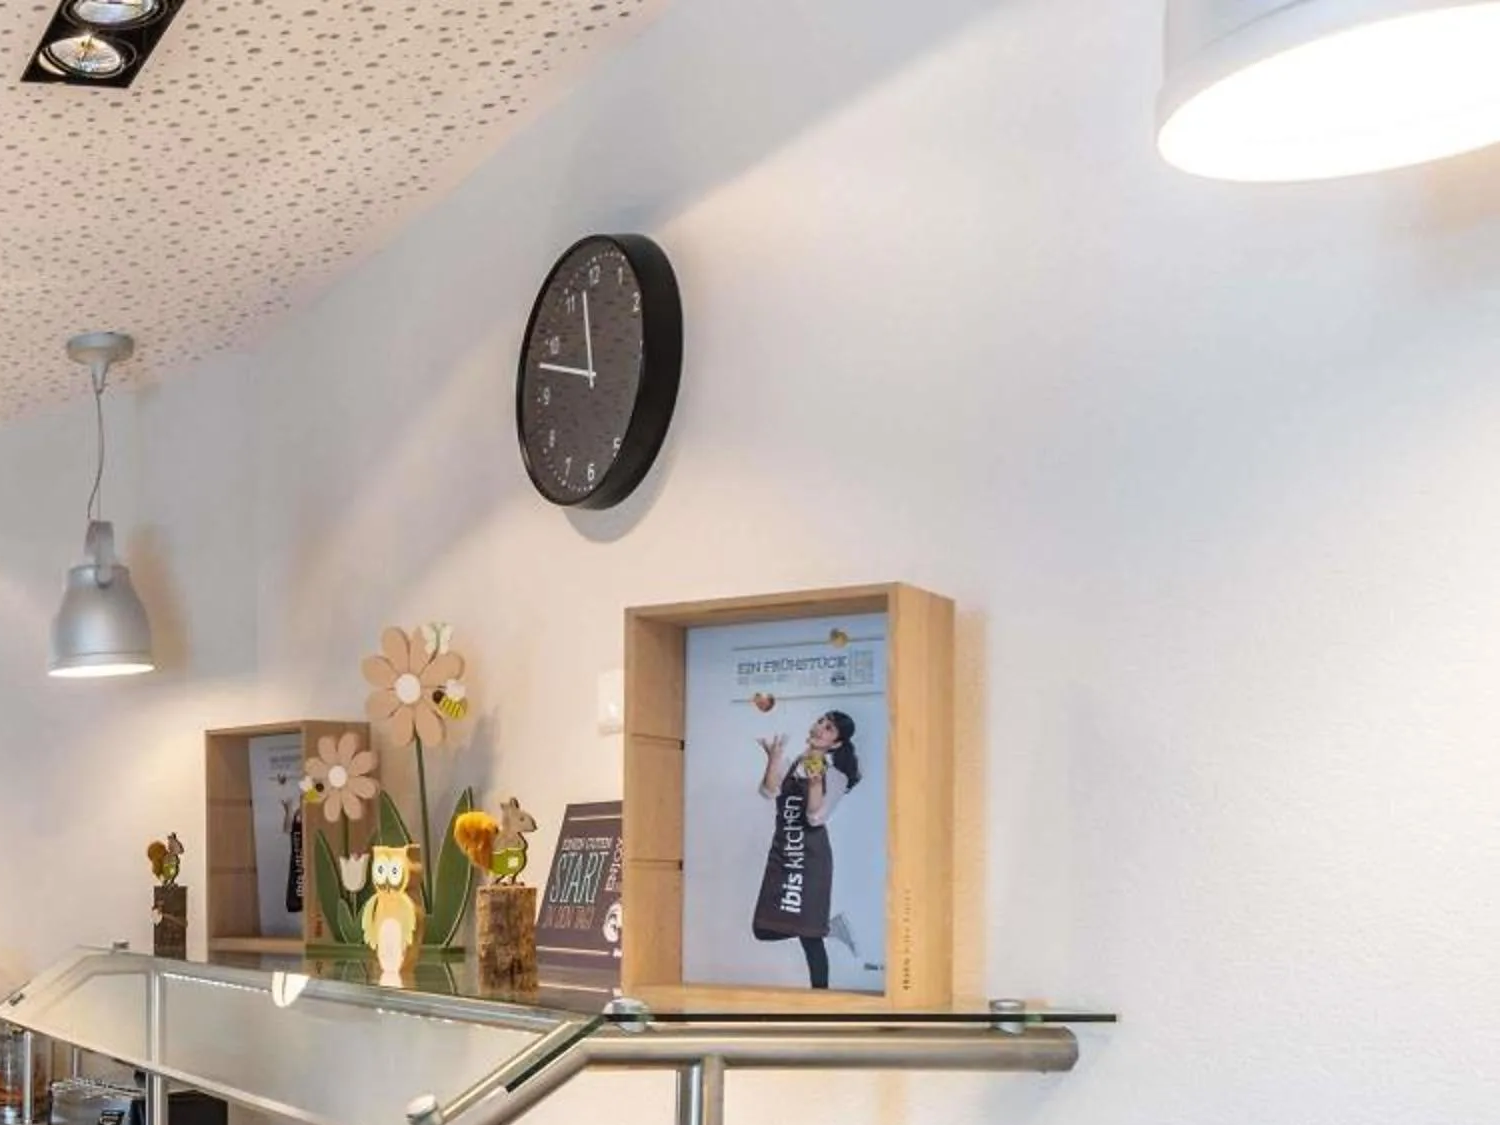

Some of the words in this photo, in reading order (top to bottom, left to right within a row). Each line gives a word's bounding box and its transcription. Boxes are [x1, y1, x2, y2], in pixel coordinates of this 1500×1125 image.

[588, 264, 601, 285] 12
[617, 266, 624, 286] 1
[632, 291, 641, 313] 2
[587, 463, 595, 482] 6
[783, 795, 804, 869] kitchen
[549, 852, 610, 903] START
[780, 872, 803, 914] ibis
